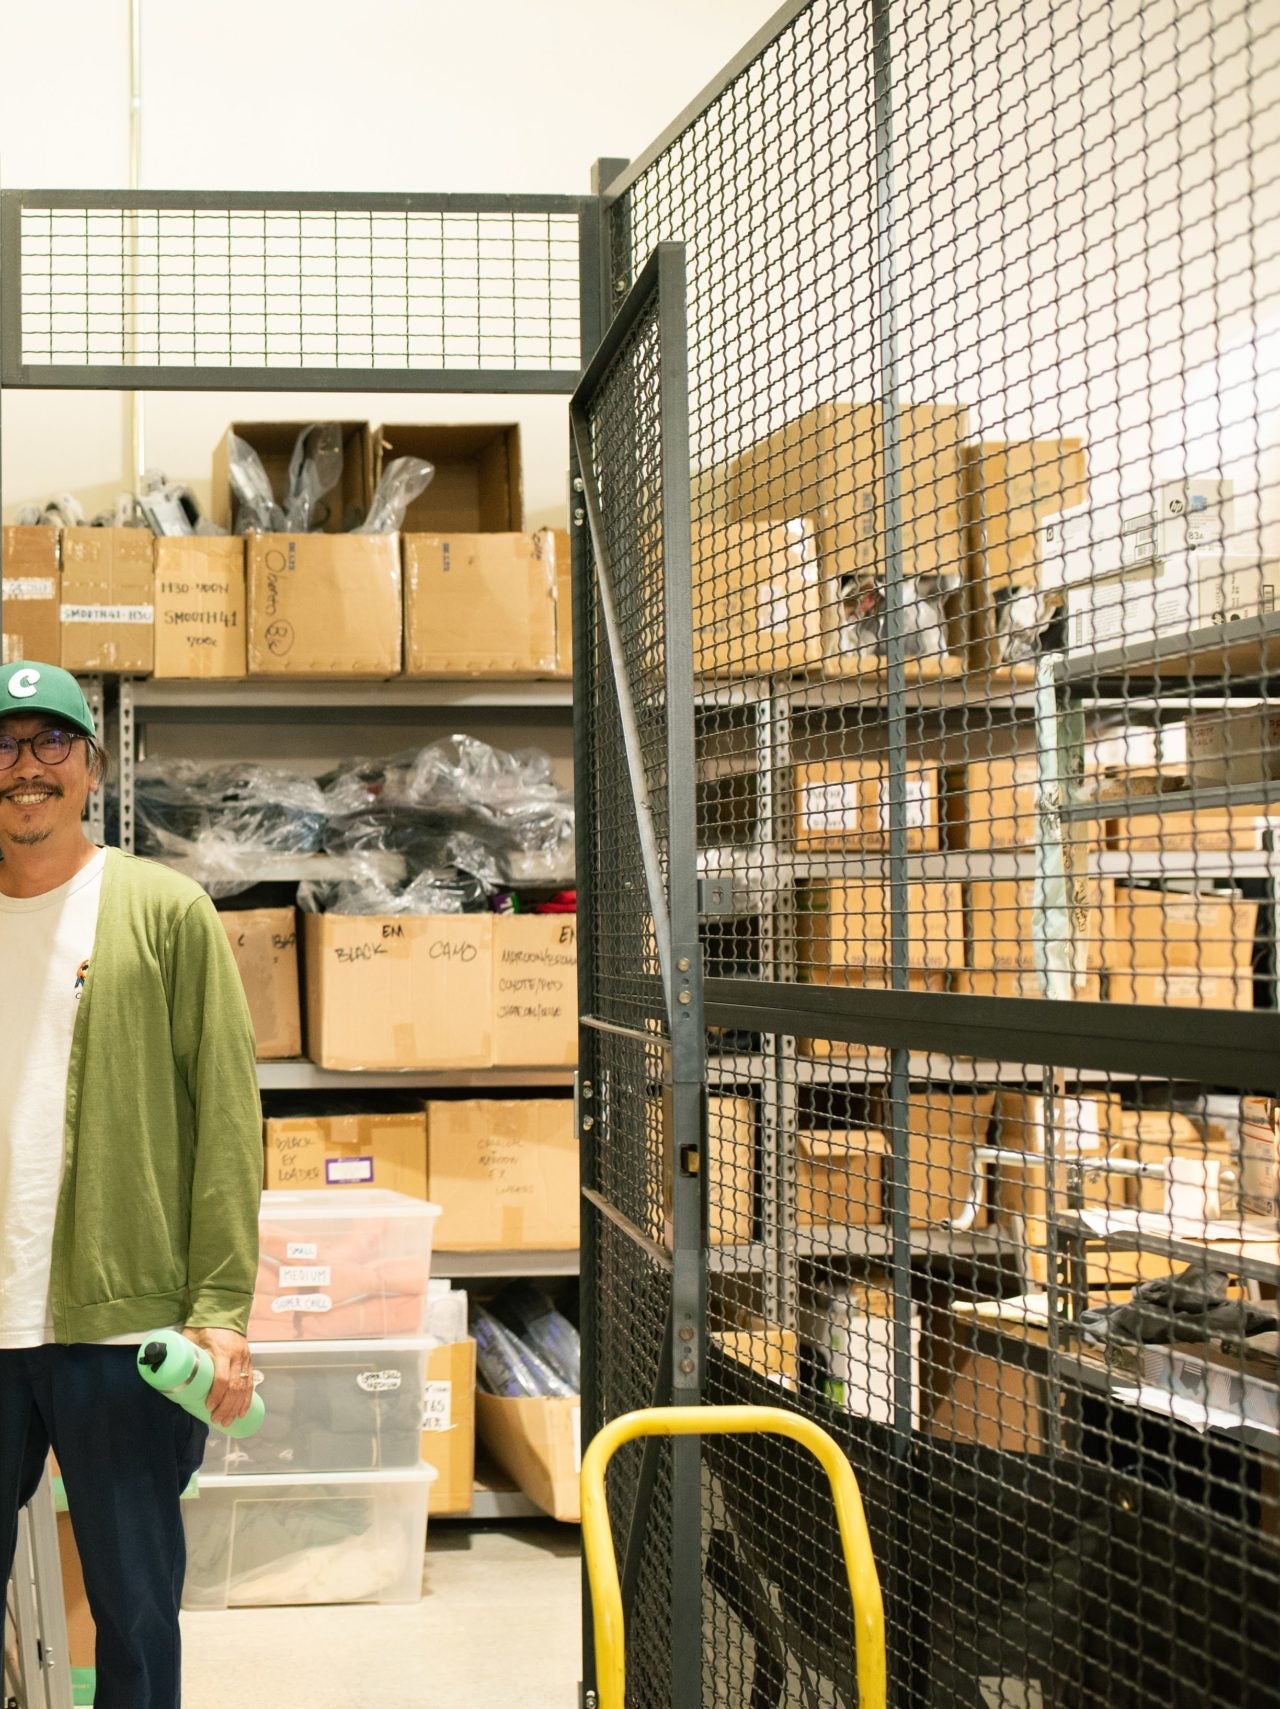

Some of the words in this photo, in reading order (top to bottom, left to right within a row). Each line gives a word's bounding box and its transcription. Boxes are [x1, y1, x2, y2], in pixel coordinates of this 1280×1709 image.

[8, 668, 41, 699] C
[335, 943, 387, 962] BLACK
[429, 942, 477, 961] CAMO
[284, 1270, 327, 1282] MEDIUM
